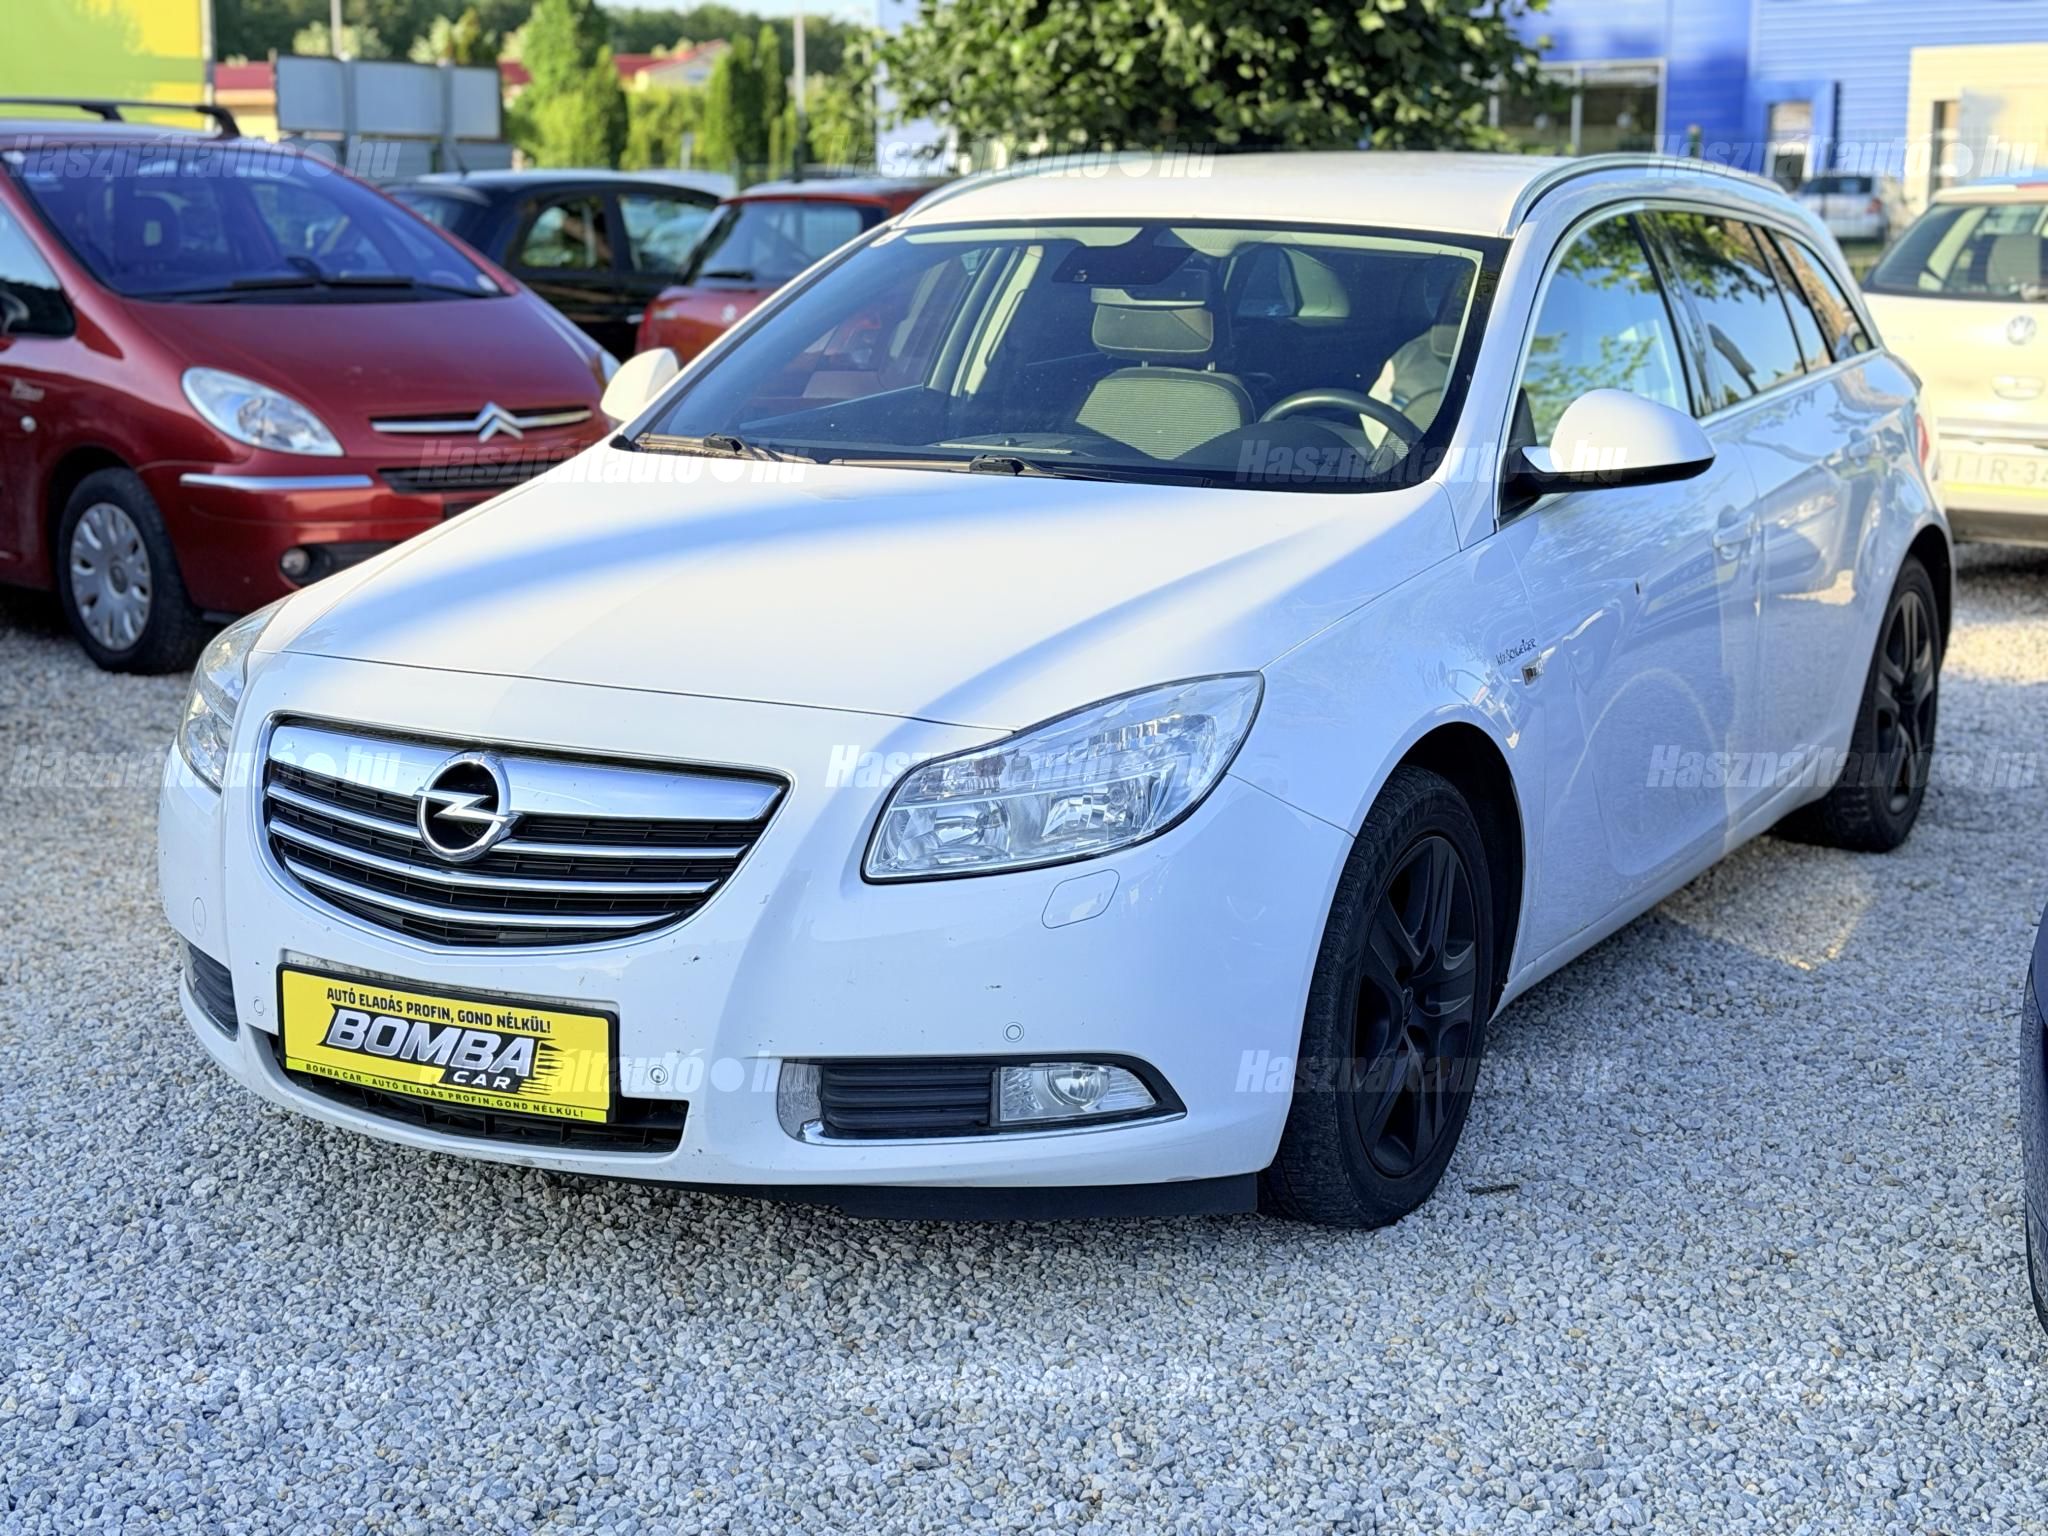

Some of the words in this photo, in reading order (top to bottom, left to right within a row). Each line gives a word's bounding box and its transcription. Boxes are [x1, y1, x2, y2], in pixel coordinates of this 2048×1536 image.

[327, 987, 356, 1004] AUTÓ
[359, 993, 403, 1013] ELADÁS
[406, 1002, 454, 1023] PROFIN,
[457, 1009, 493, 1026] GOND
[496, 1012, 551, 1034] NÉLKÜL!
[326, 1008, 535, 1077] BOMBA
[306, 1063, 339, 1078] BOMBA
[342, 1071, 362, 1083] CAR
[371, 1076, 399, 1090] AUTÓ
[402, 1082, 444, 1099] ELADÁS
[533, 1103, 585, 1118] NÉLKÜL!
[453, 1071, 511, 1090] CAR
